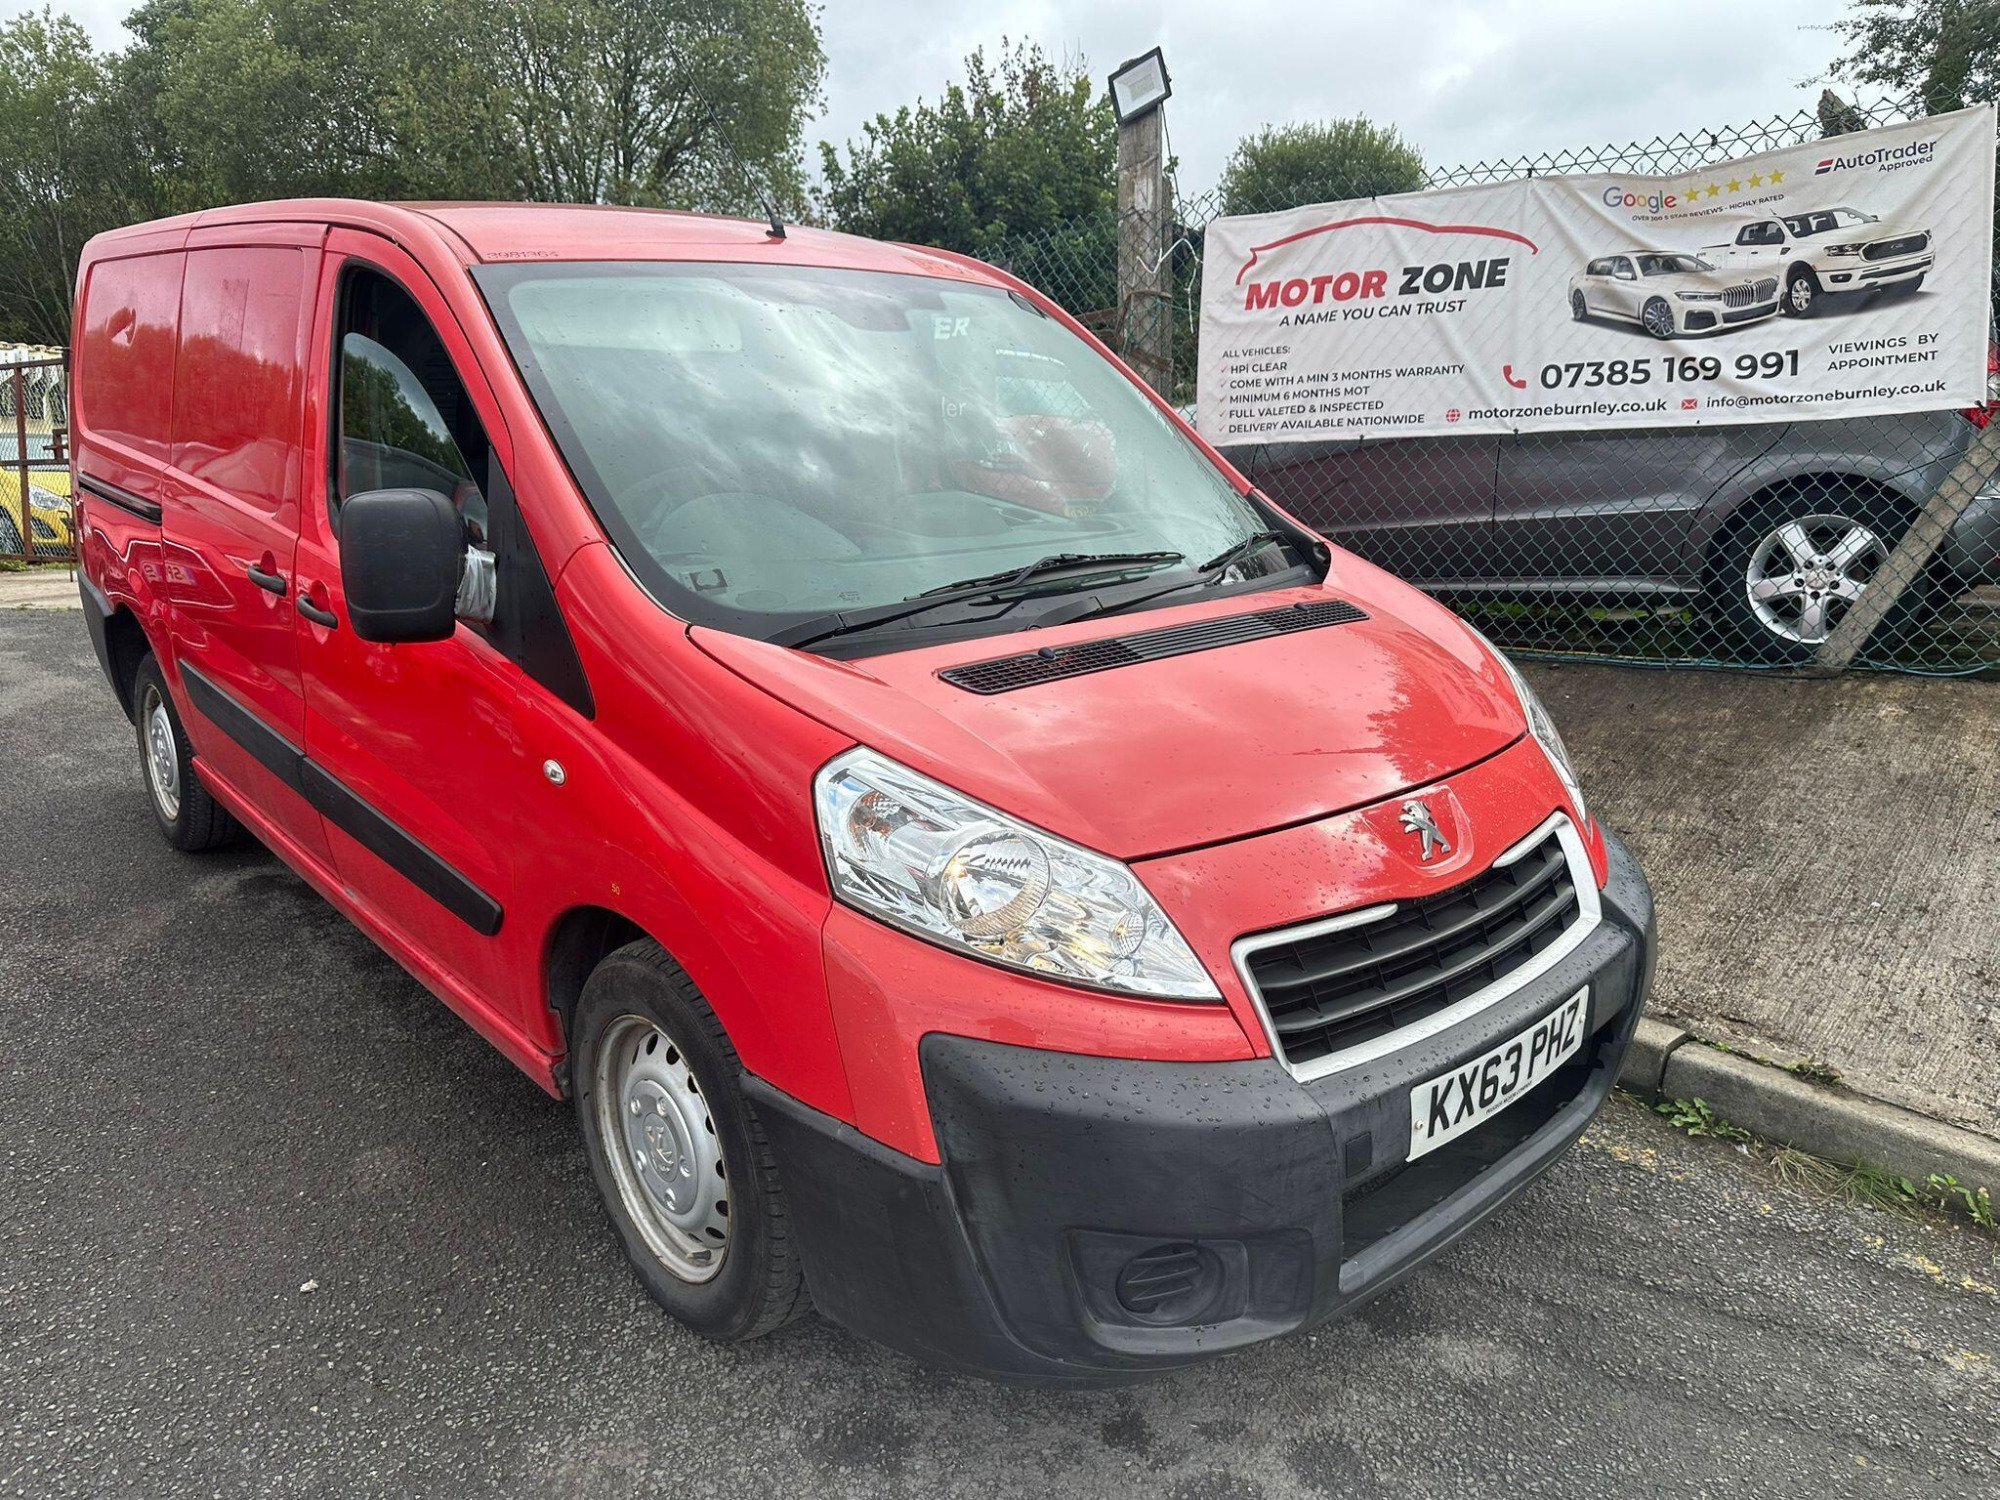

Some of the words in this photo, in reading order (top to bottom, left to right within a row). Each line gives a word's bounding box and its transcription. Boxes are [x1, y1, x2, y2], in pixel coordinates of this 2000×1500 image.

[1833, 141, 1937, 171] AutoTrader
[1879, 154, 1933, 172] Approved
[1603, 186, 1677, 214] Google
[1632, 214, 1650, 222] OVER
[1689, 205, 1724, 218] REVIEWS
[1729, 199, 1757, 211] HIGHLY
[1758, 194, 1785, 204] RATED
[1244, 270, 1387, 310] MOTOR
[1398, 258, 1510, 296] ZONE
[1279, 315, 1290, 327] A
[1294, 310, 1337, 326] NAME
[1343, 307, 1375, 322] YOU
[1378, 303, 1411, 319] CAN
[1416, 300, 1467, 316] TRUST
[1222, 350, 1240, 358] ALL
[1242, 346, 1291, 357] VEHICLES:
[1828, 337, 1907, 354] VIEWINGS
[1918, 333, 1939, 345] BY
[1252, 362, 1288, 372] CLEAR
[1540, 358, 1651, 390] 07385
[1662, 356, 1722, 383] 169
[1734, 349, 1799, 380] 991
[1827, 350, 1939, 371] APPOINTMENT
[1230, 379, 1262, 389] COME
[1264, 376, 1294, 387] WITH
[1296, 376, 1304, 384] A
[1306, 373, 1329, 383] MIN
[1331, 373, 1338, 382] 3
[1342, 368, 1392, 381] MONTHS
[1396, 364, 1465, 377] WARRANTY
[1230, 392, 1280, 404] MINIMUM
[1283, 391, 1290, 400] 6
[1292, 388, 1341, 400] MONTHS
[1344, 386, 1370, 396] MOT
[1706, 380, 1946, 409] info@motorzoneburnley.co.uk
[1229, 409, 1255, 418] FULL
[1258, 404, 1306, 417] VALETED
[1308, 404, 1316, 414] &
[1320, 400, 1384, 413] INSPECTED
[1468, 398, 1667, 420] motorzoneburnley.co.uk
[1228, 422, 1280, 434] DELIVERY
[1280, 418, 1344, 430] AVAILABLE
[1346, 414, 1425, 426] NATIONWIDE
[1427, 1041, 1523, 1138] KX63
[1527, 998, 1581, 1080] PHZ
